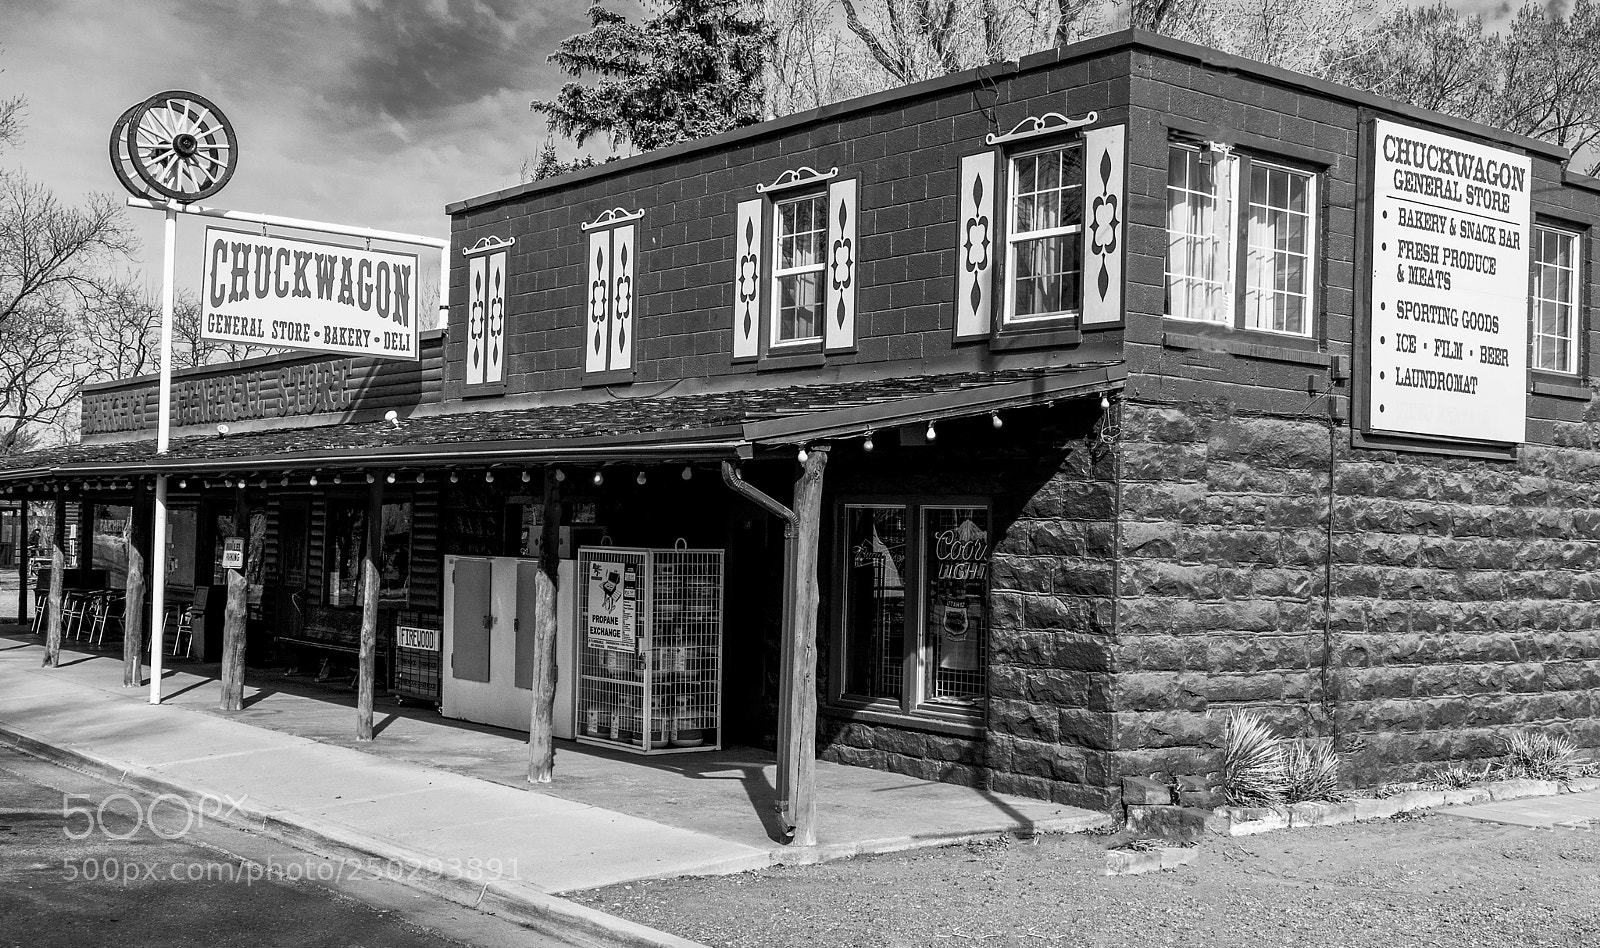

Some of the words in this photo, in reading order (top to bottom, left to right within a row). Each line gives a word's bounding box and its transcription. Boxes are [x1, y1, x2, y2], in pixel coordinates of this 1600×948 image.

[1383, 134, 1526, 192] CHUCKWAGON
[1394, 169, 1462, 202] GENERAL
[1466, 184, 1510, 213] STORE
[1398, 207, 1447, 234] BAKERY
[1449, 218, 1457, 236] &
[1460, 220, 1496, 245] SNACK
[1499, 228, 1521, 250] BAR
[1397, 239, 1440, 264] FRESH
[1442, 247, 1497, 275] PRODUCE
[210, 238, 411, 328] CHUCKWAGON
[1397, 264, 1404, 282] &
[1408, 265, 1451, 291] MEATS
[207, 313, 265, 338] GENERAL
[271, 319, 311, 342] STORE
[323, 325, 371, 348] BAKERY
[383, 331, 411, 352] DELI
[1396, 300, 1458, 327] SPORTING
[1462, 310, 1499, 334] GOODS
[1396, 333, 1417, 353] ICE
[1434, 338, 1463, 360] FILM
[1480, 345, 1509, 367] BEER
[86, 389, 150, 434] BAKERY
[175, 370, 266, 427] GENERAL
[276, 358, 353, 417] STORE
[1395, 366, 1478, 395] LAUNDROMAT
[590, 626, 621, 638] EXCHANGE
[592, 615, 619, 626] PROPANE
[401, 628, 434, 649] FIREWOOD
